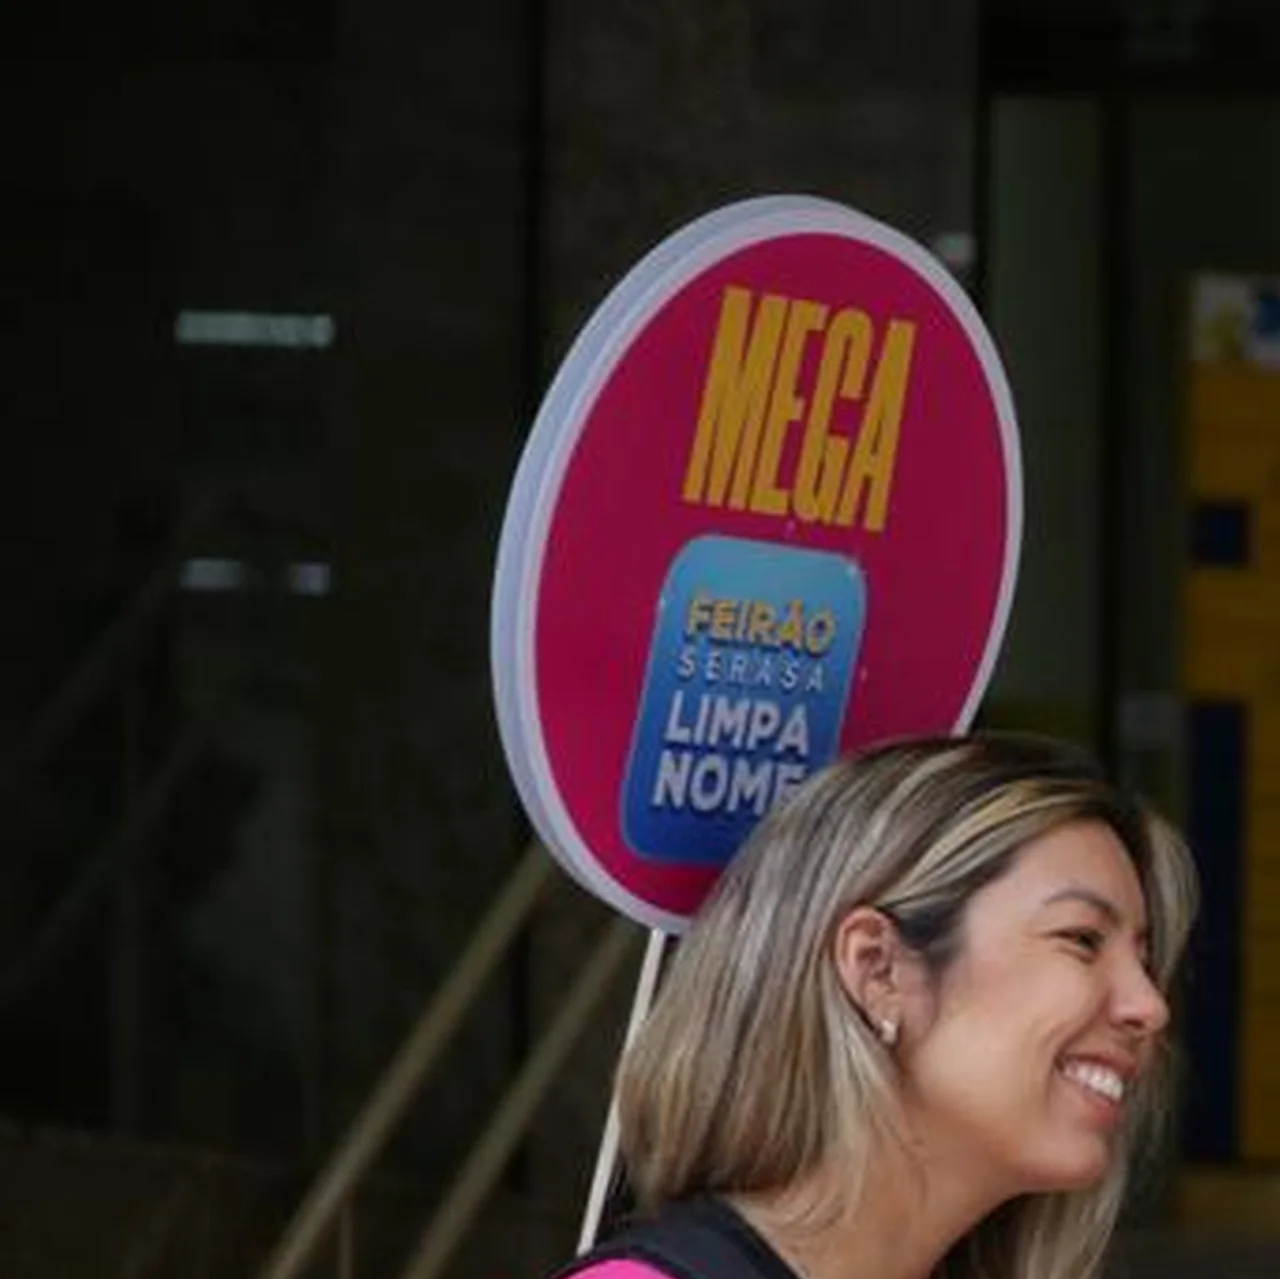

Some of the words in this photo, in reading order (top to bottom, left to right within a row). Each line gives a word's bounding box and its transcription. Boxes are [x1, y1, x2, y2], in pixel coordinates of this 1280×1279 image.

[683, 285, 918, 533] MEGA
[685, 593, 838, 655] FEIRÃO
[676, 645, 824, 692] SERASA
[664, 688, 811, 756] LIMPA
[651, 750, 809, 816] NOME
